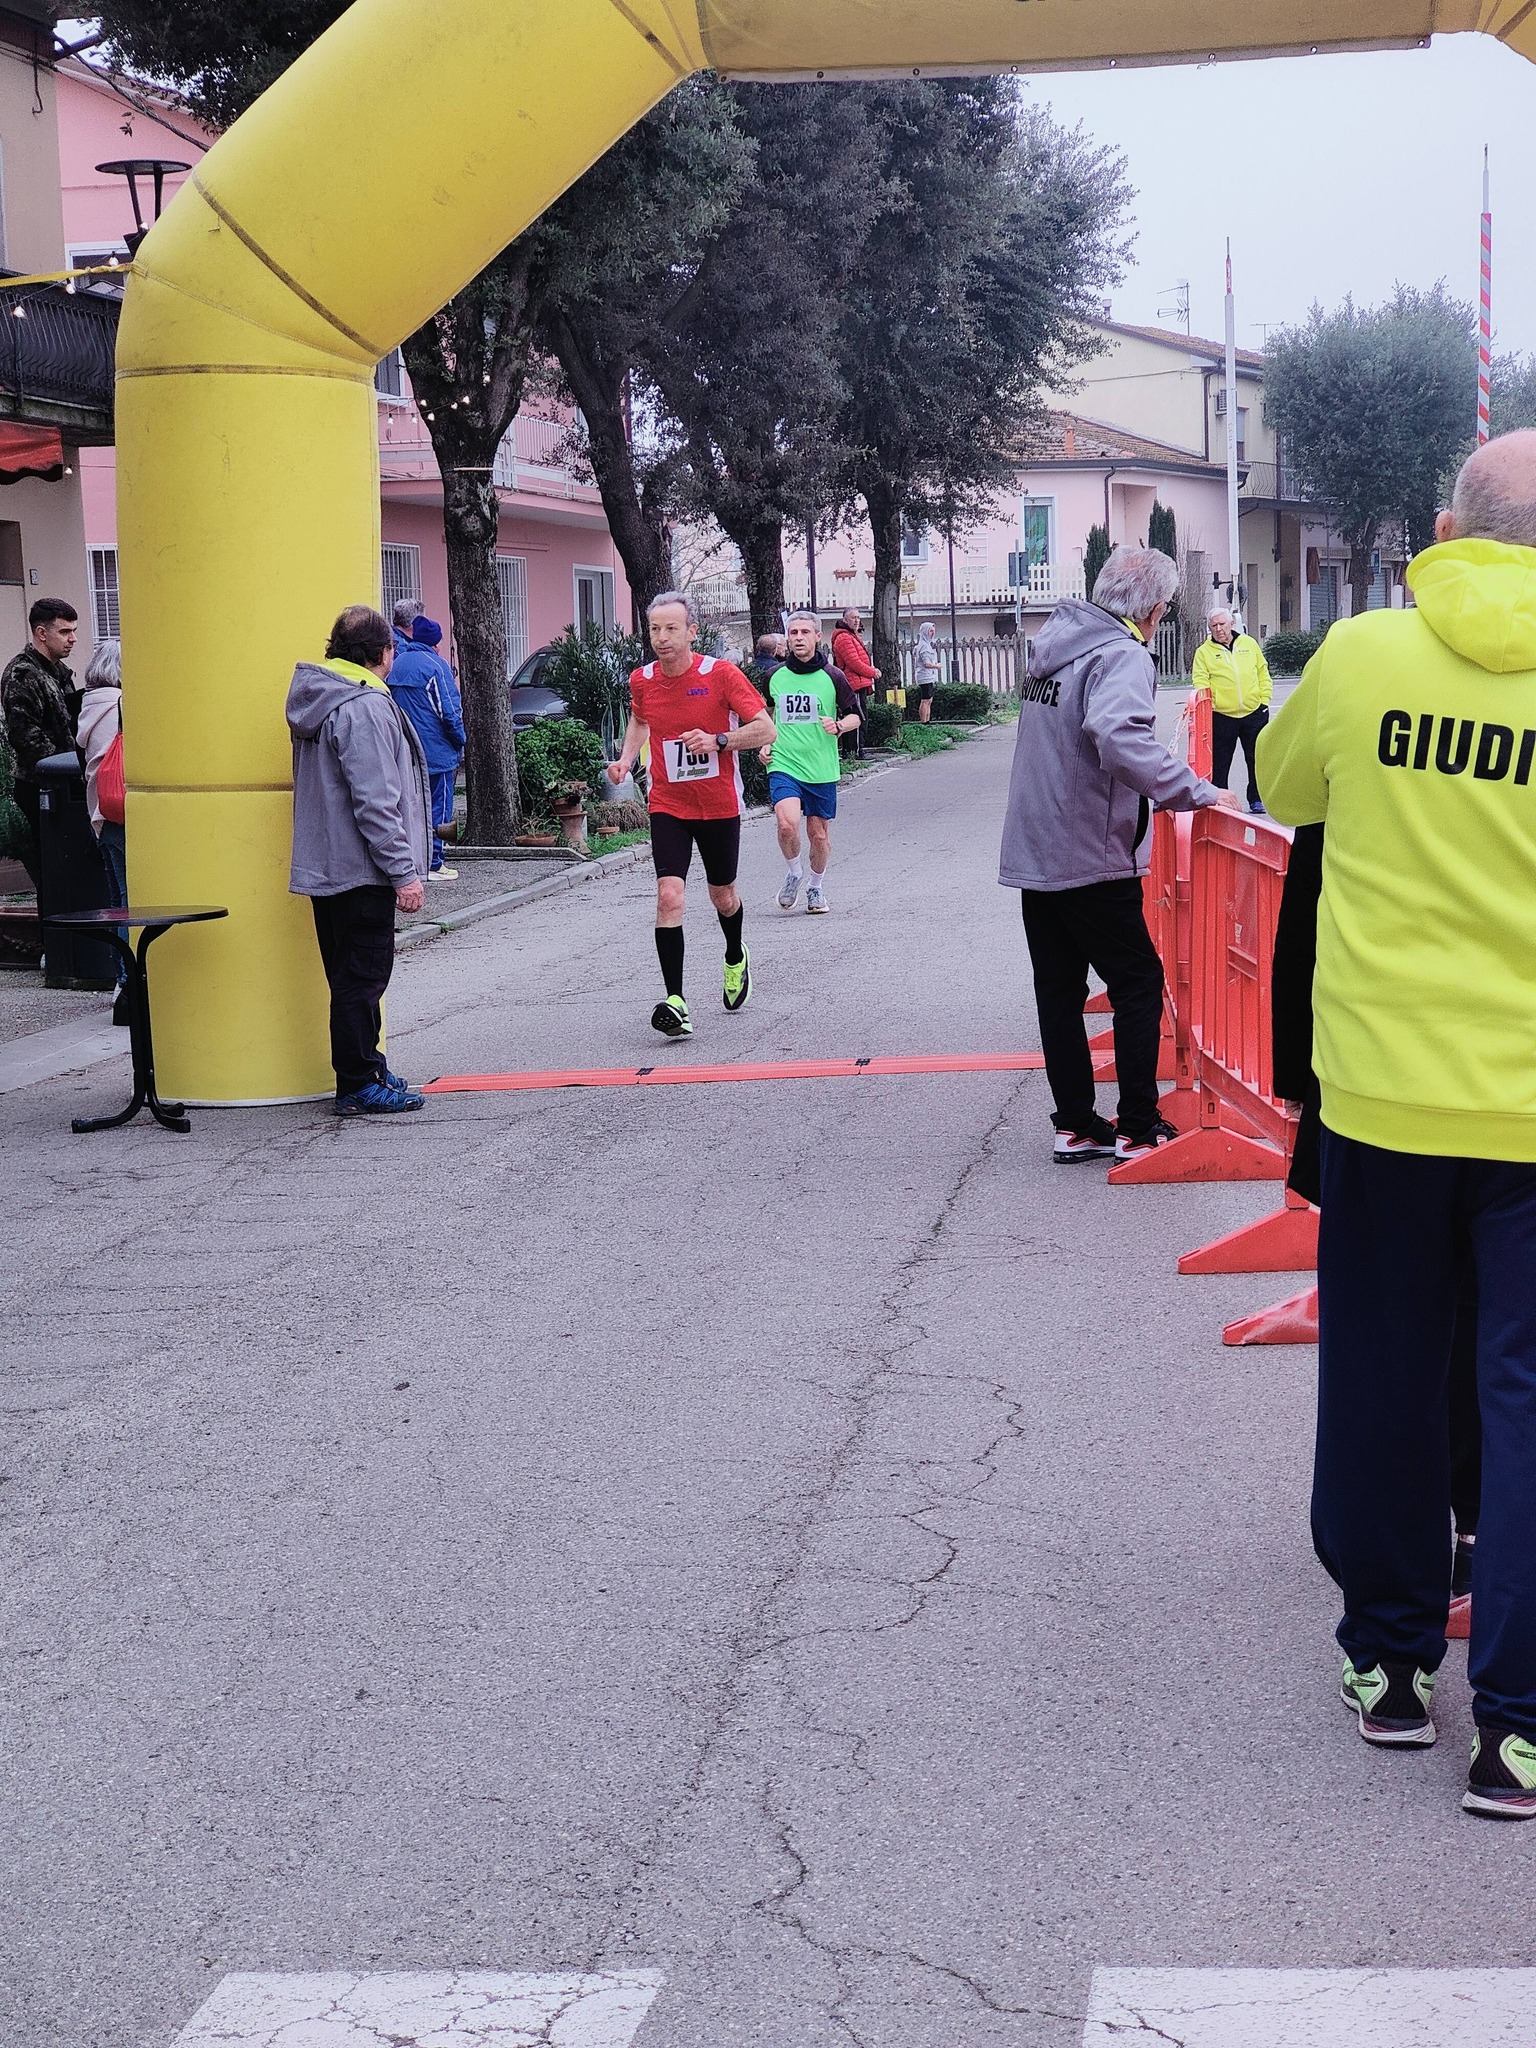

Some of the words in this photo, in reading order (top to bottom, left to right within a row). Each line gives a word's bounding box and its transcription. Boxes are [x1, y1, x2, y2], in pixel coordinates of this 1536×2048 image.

[786, 695, 811, 713] 523
[1022, 677, 1062, 707] UDICE
[1377, 709, 1536, 786] GIUDI
